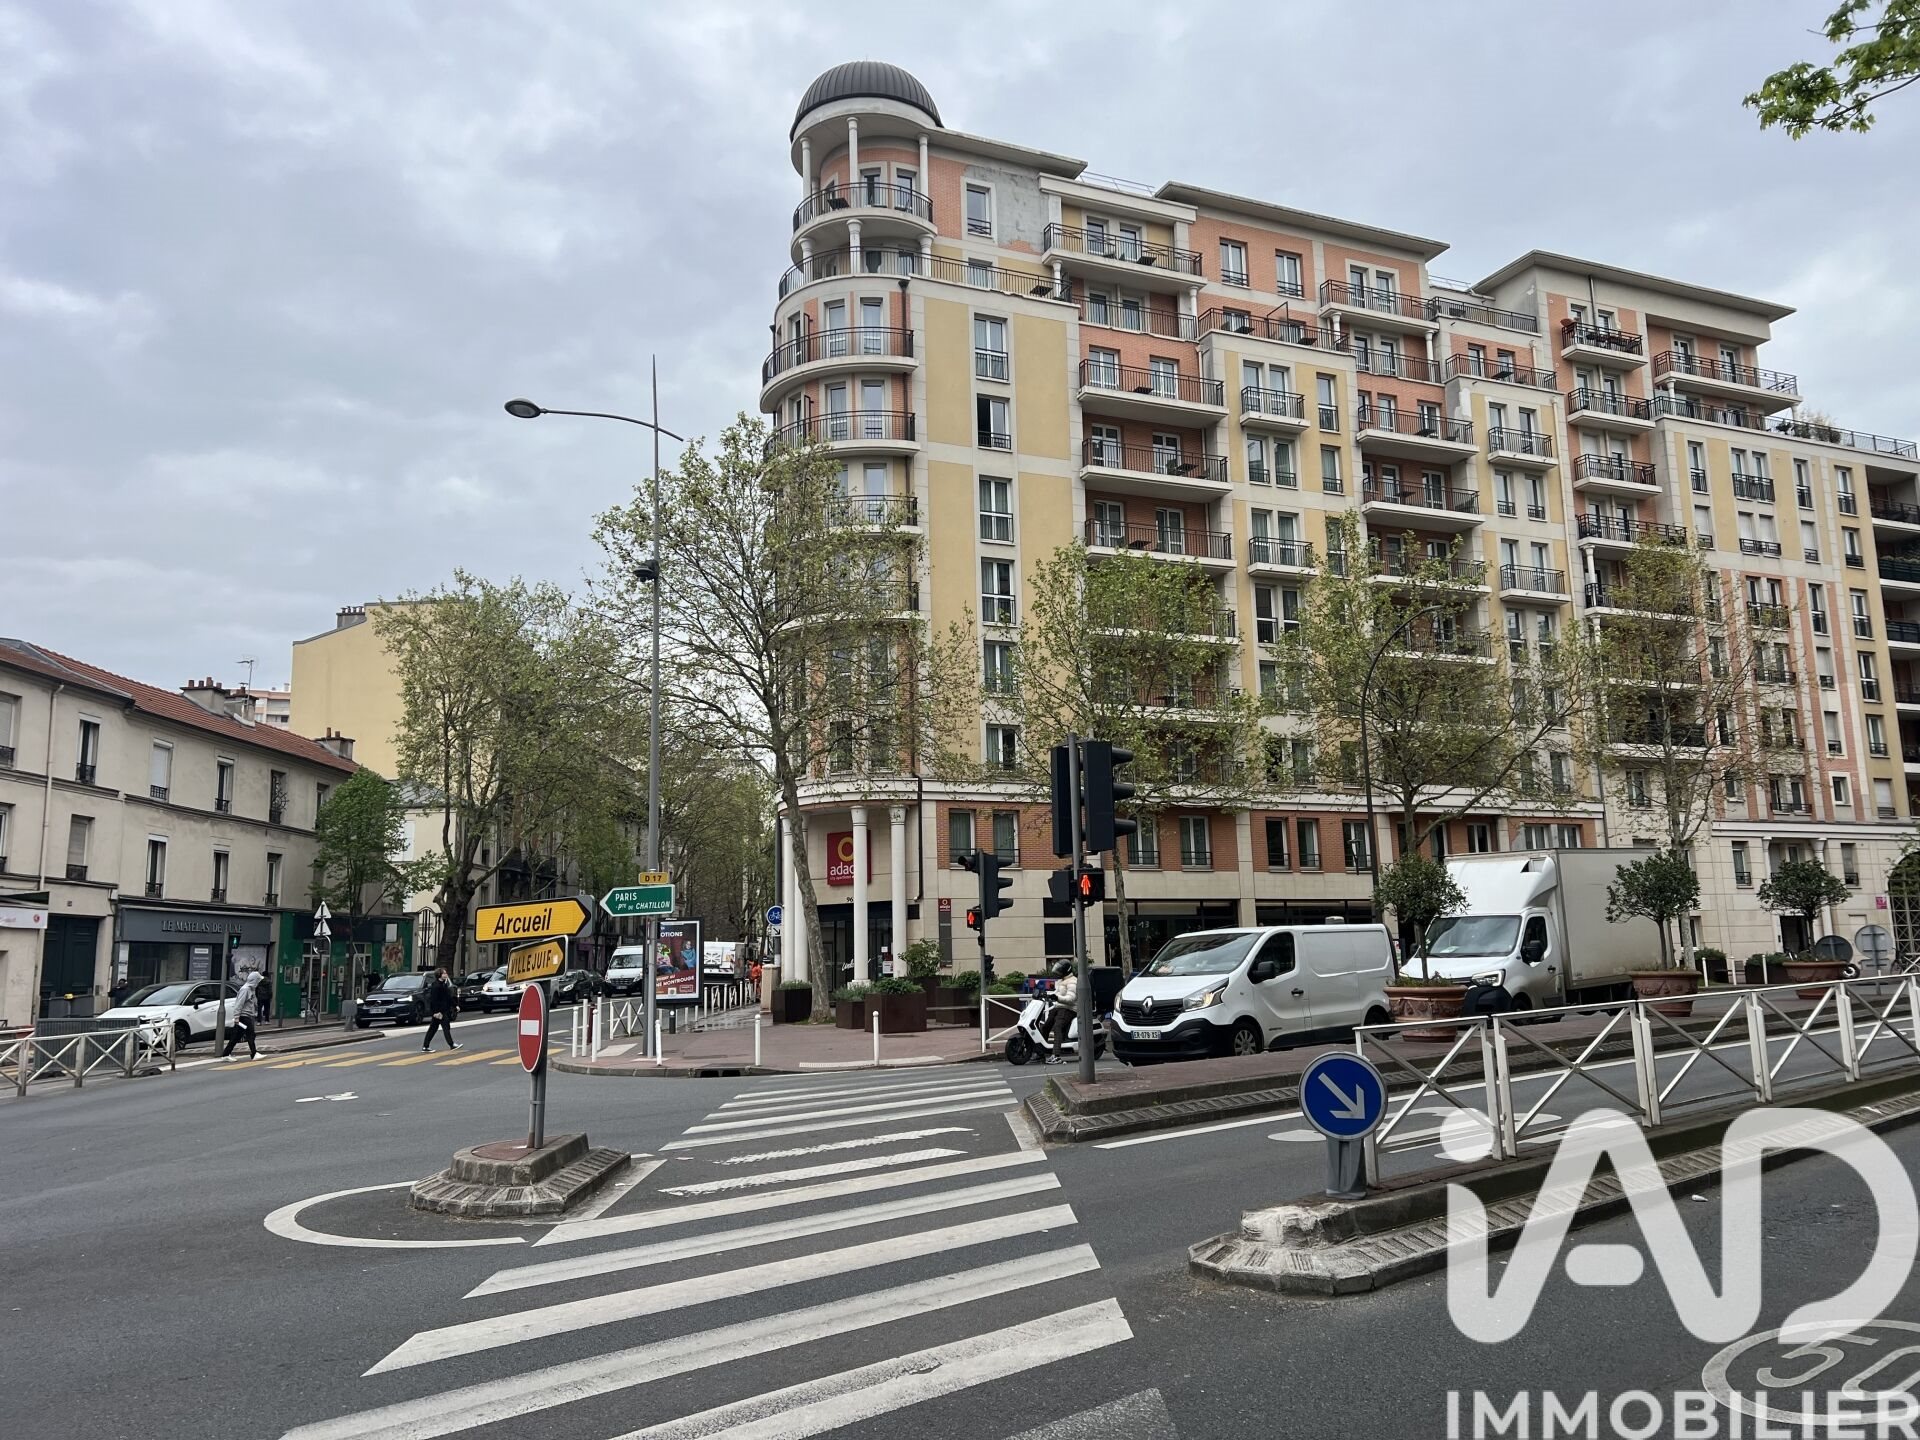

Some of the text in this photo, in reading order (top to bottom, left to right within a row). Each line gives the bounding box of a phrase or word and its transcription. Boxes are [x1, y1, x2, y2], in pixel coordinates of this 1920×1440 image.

[615, 892, 637, 901] PARIS
[636, 900, 671, 910] CHATILLON
[162, 920, 173, 931] LE
[176, 920, 210, 932] MATELAS
[212, 922, 222, 933] DE
[493, 907, 552, 935] Arcueil
[511, 949, 552, 975] VILLEJUIF
